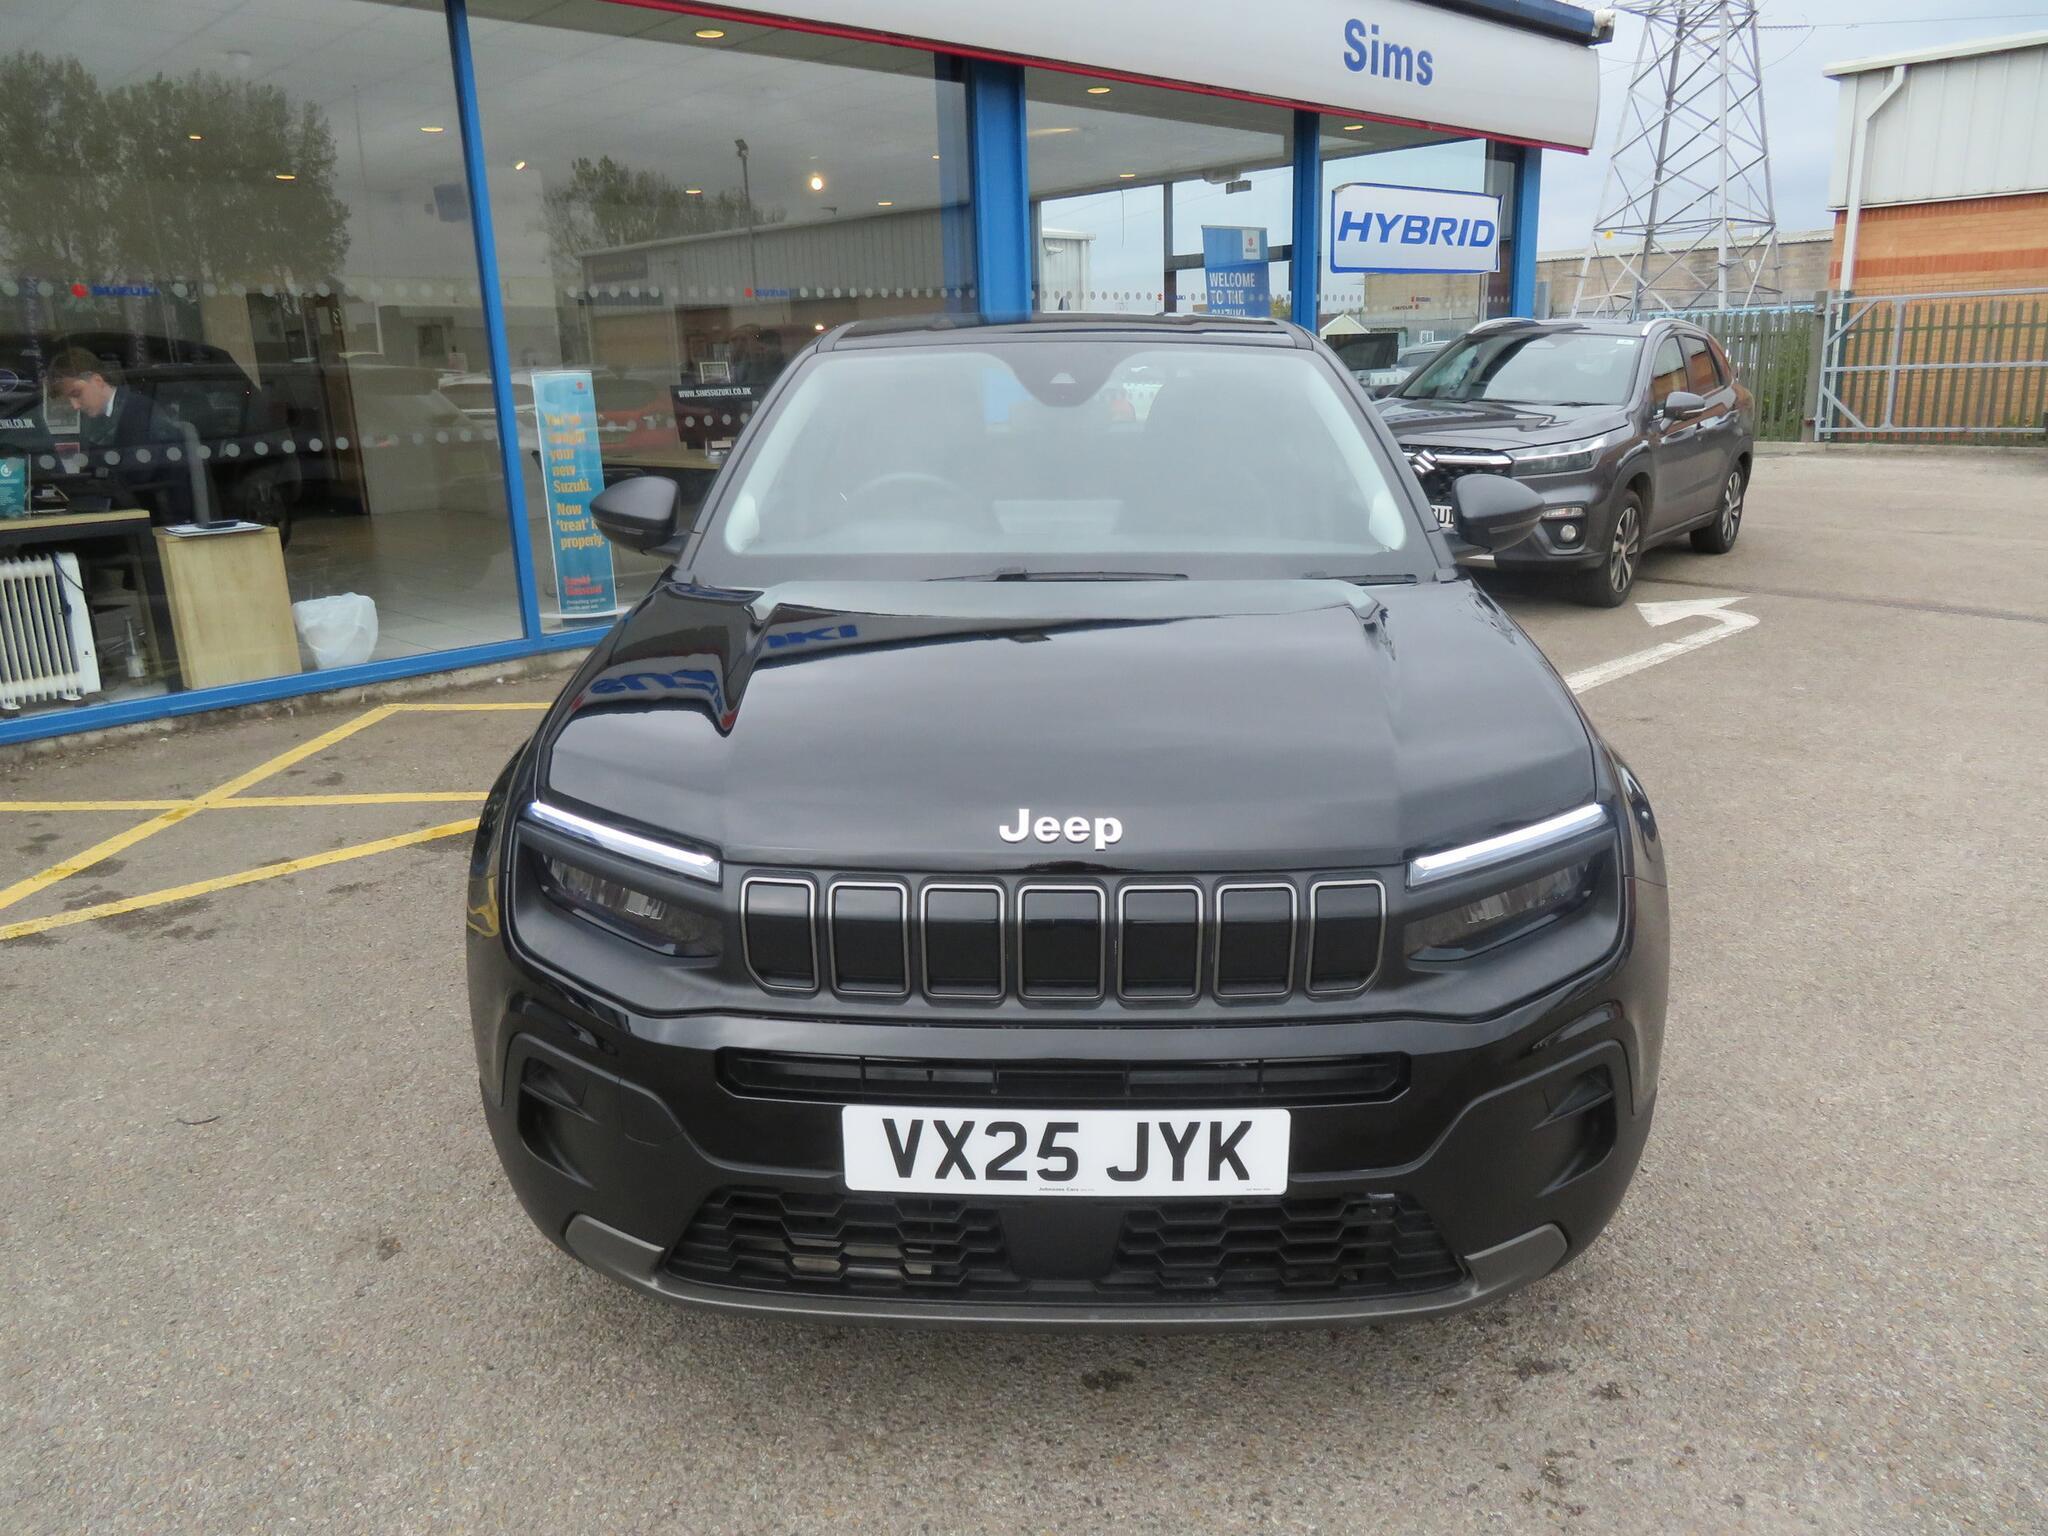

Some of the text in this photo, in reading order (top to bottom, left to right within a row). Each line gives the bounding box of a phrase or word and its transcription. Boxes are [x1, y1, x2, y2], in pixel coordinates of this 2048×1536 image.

[1343, 18, 1433, 86] Sims
[1338, 211, 1496, 248] HYBRID
[1209, 272, 1256, 287] WELCOME
[1210, 290, 1245, 305] TO THE
[550, 449, 575, 463] your
[552, 465, 576, 476] new
[553, 478, 592, 493] Suzuki.
[557, 503, 582, 515] Now
[561, 534, 604, 550] properly.
[999, 808, 1123, 851] Jeep
[882, 1118, 1253, 1182] VX25 JYK
